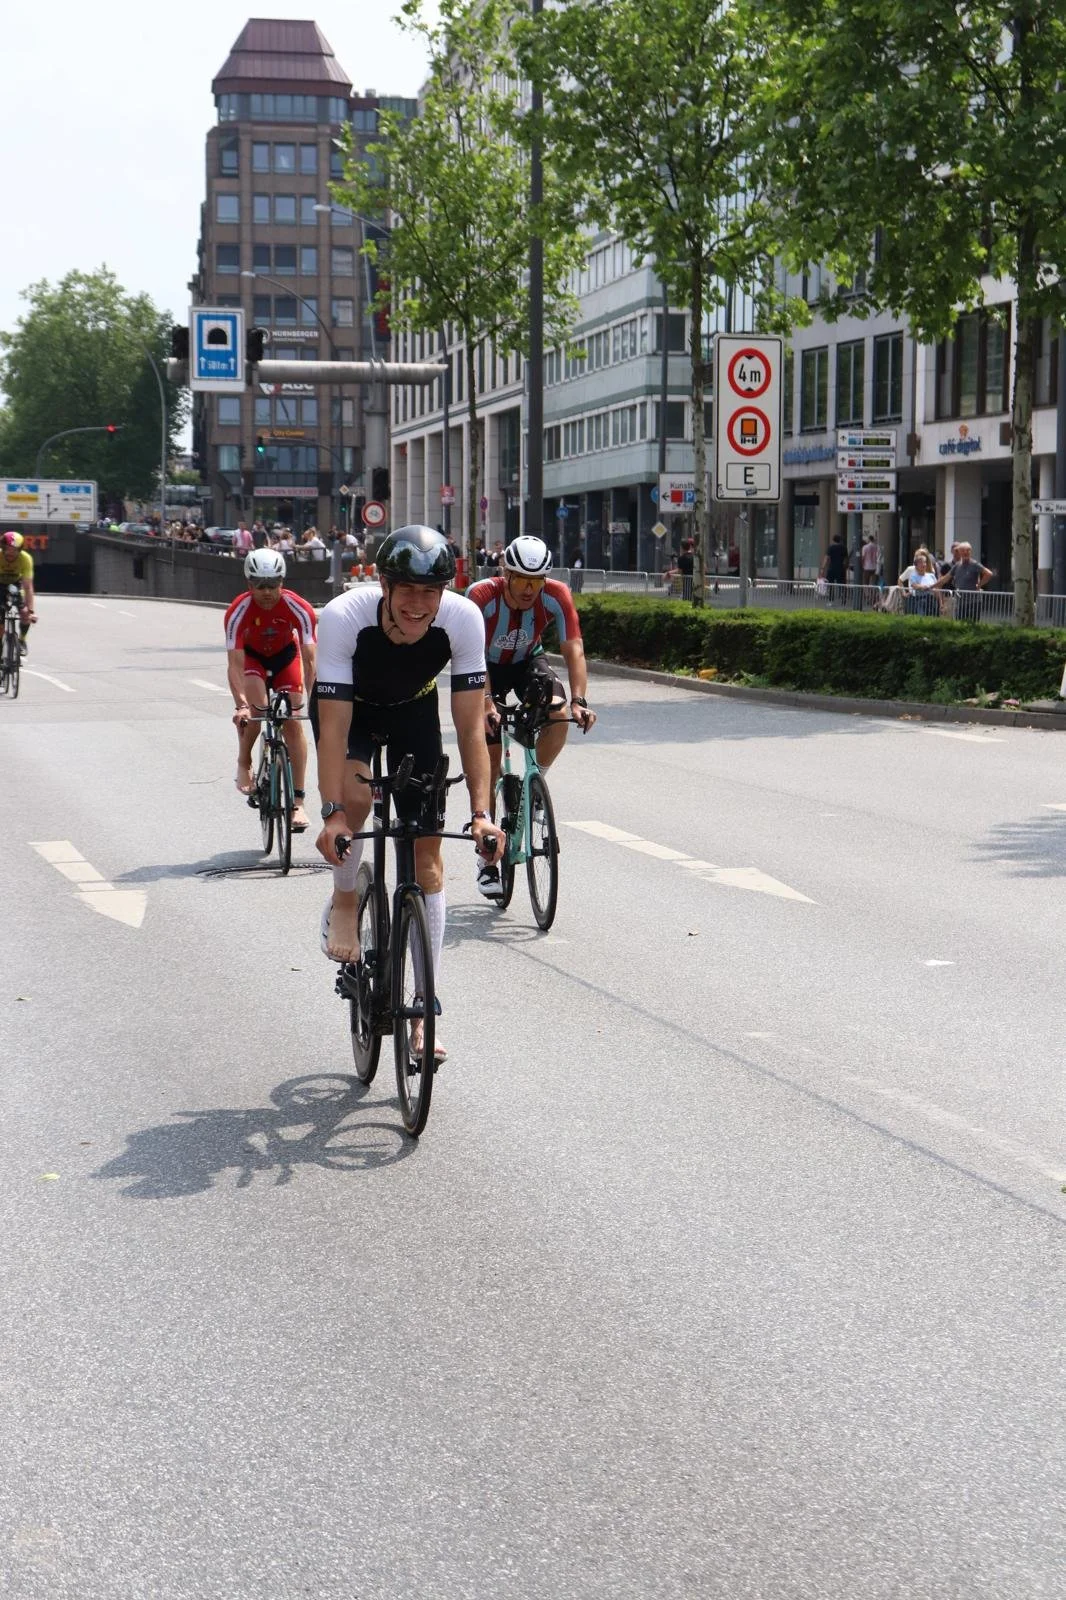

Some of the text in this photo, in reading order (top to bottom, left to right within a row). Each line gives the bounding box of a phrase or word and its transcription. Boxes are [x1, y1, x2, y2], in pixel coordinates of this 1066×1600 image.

[738, 363, 761, 382] 4 m
[939, 438, 956, 456] café
[670, 481, 695, 489] Kunsth
[744, 467, 755, 485] E
[686, 492, 693, 502] P
